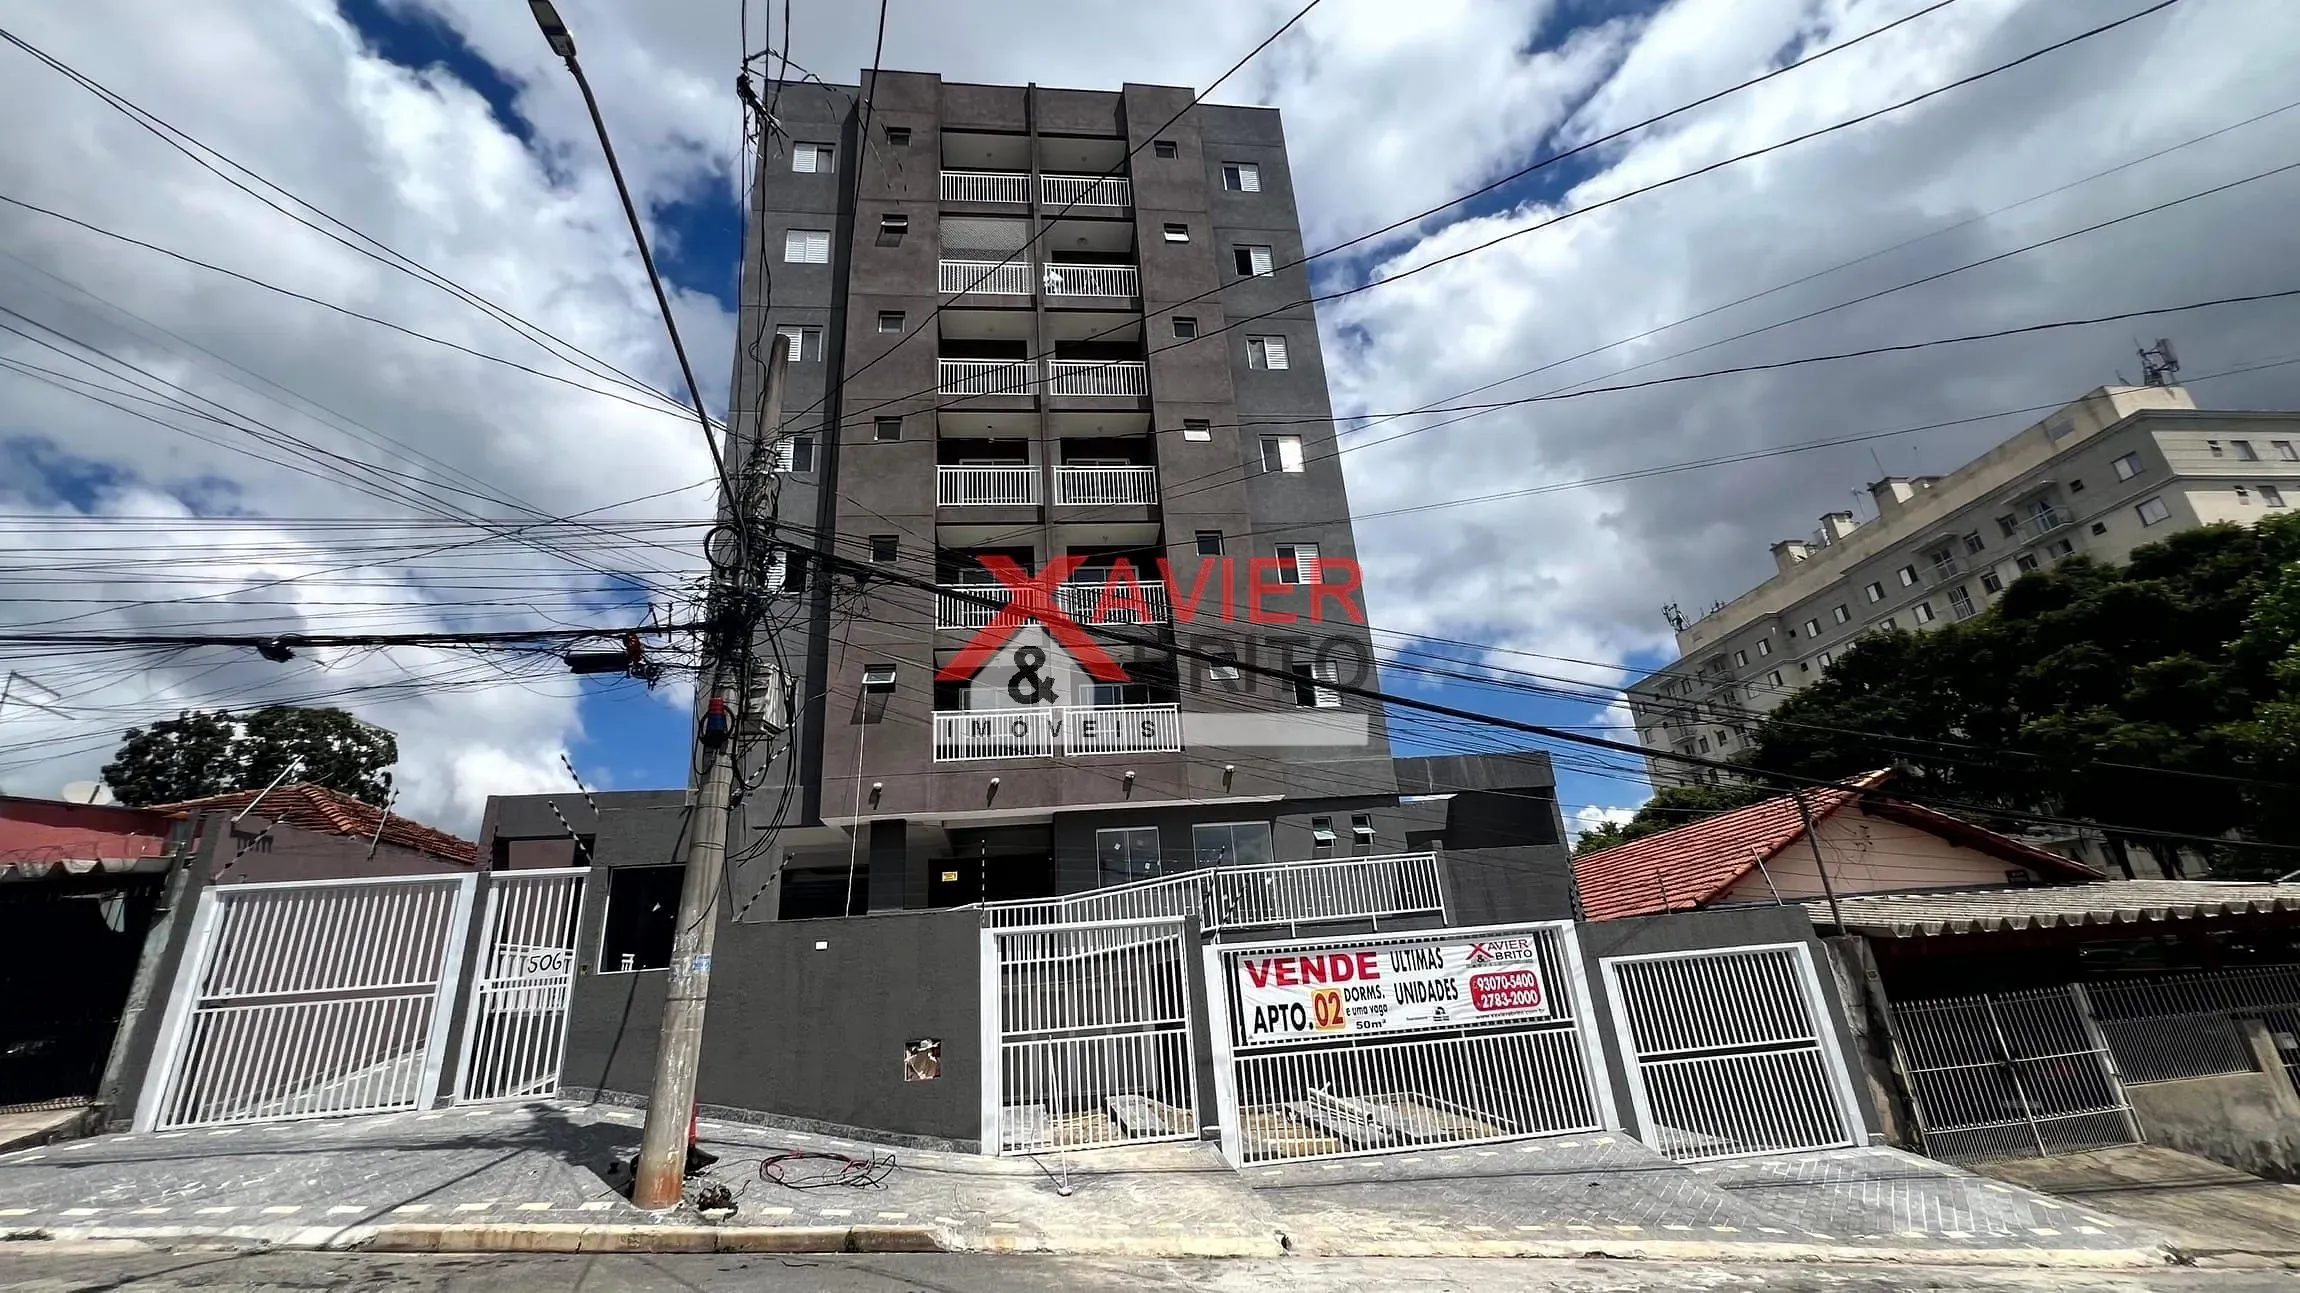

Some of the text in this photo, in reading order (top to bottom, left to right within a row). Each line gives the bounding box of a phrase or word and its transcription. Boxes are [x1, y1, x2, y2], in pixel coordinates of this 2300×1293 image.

[1466, 939, 1529, 960] XAVIER
[1495, 949, 1533, 960] BRITO
[527, 952, 562, 973] 506
[1244, 952, 1381, 988] VENDE
[1394, 977, 1459, 1005] UNIDADES
[1477, 973, 1535, 992] 93070-5400
[1344, 985, 1386, 1002] DORMS.
[1481, 989, 1539, 1009] 2783-2000
[1254, 991, 1344, 1034] APTO. 02
[1370, 1003, 1388, 1016] vaga
